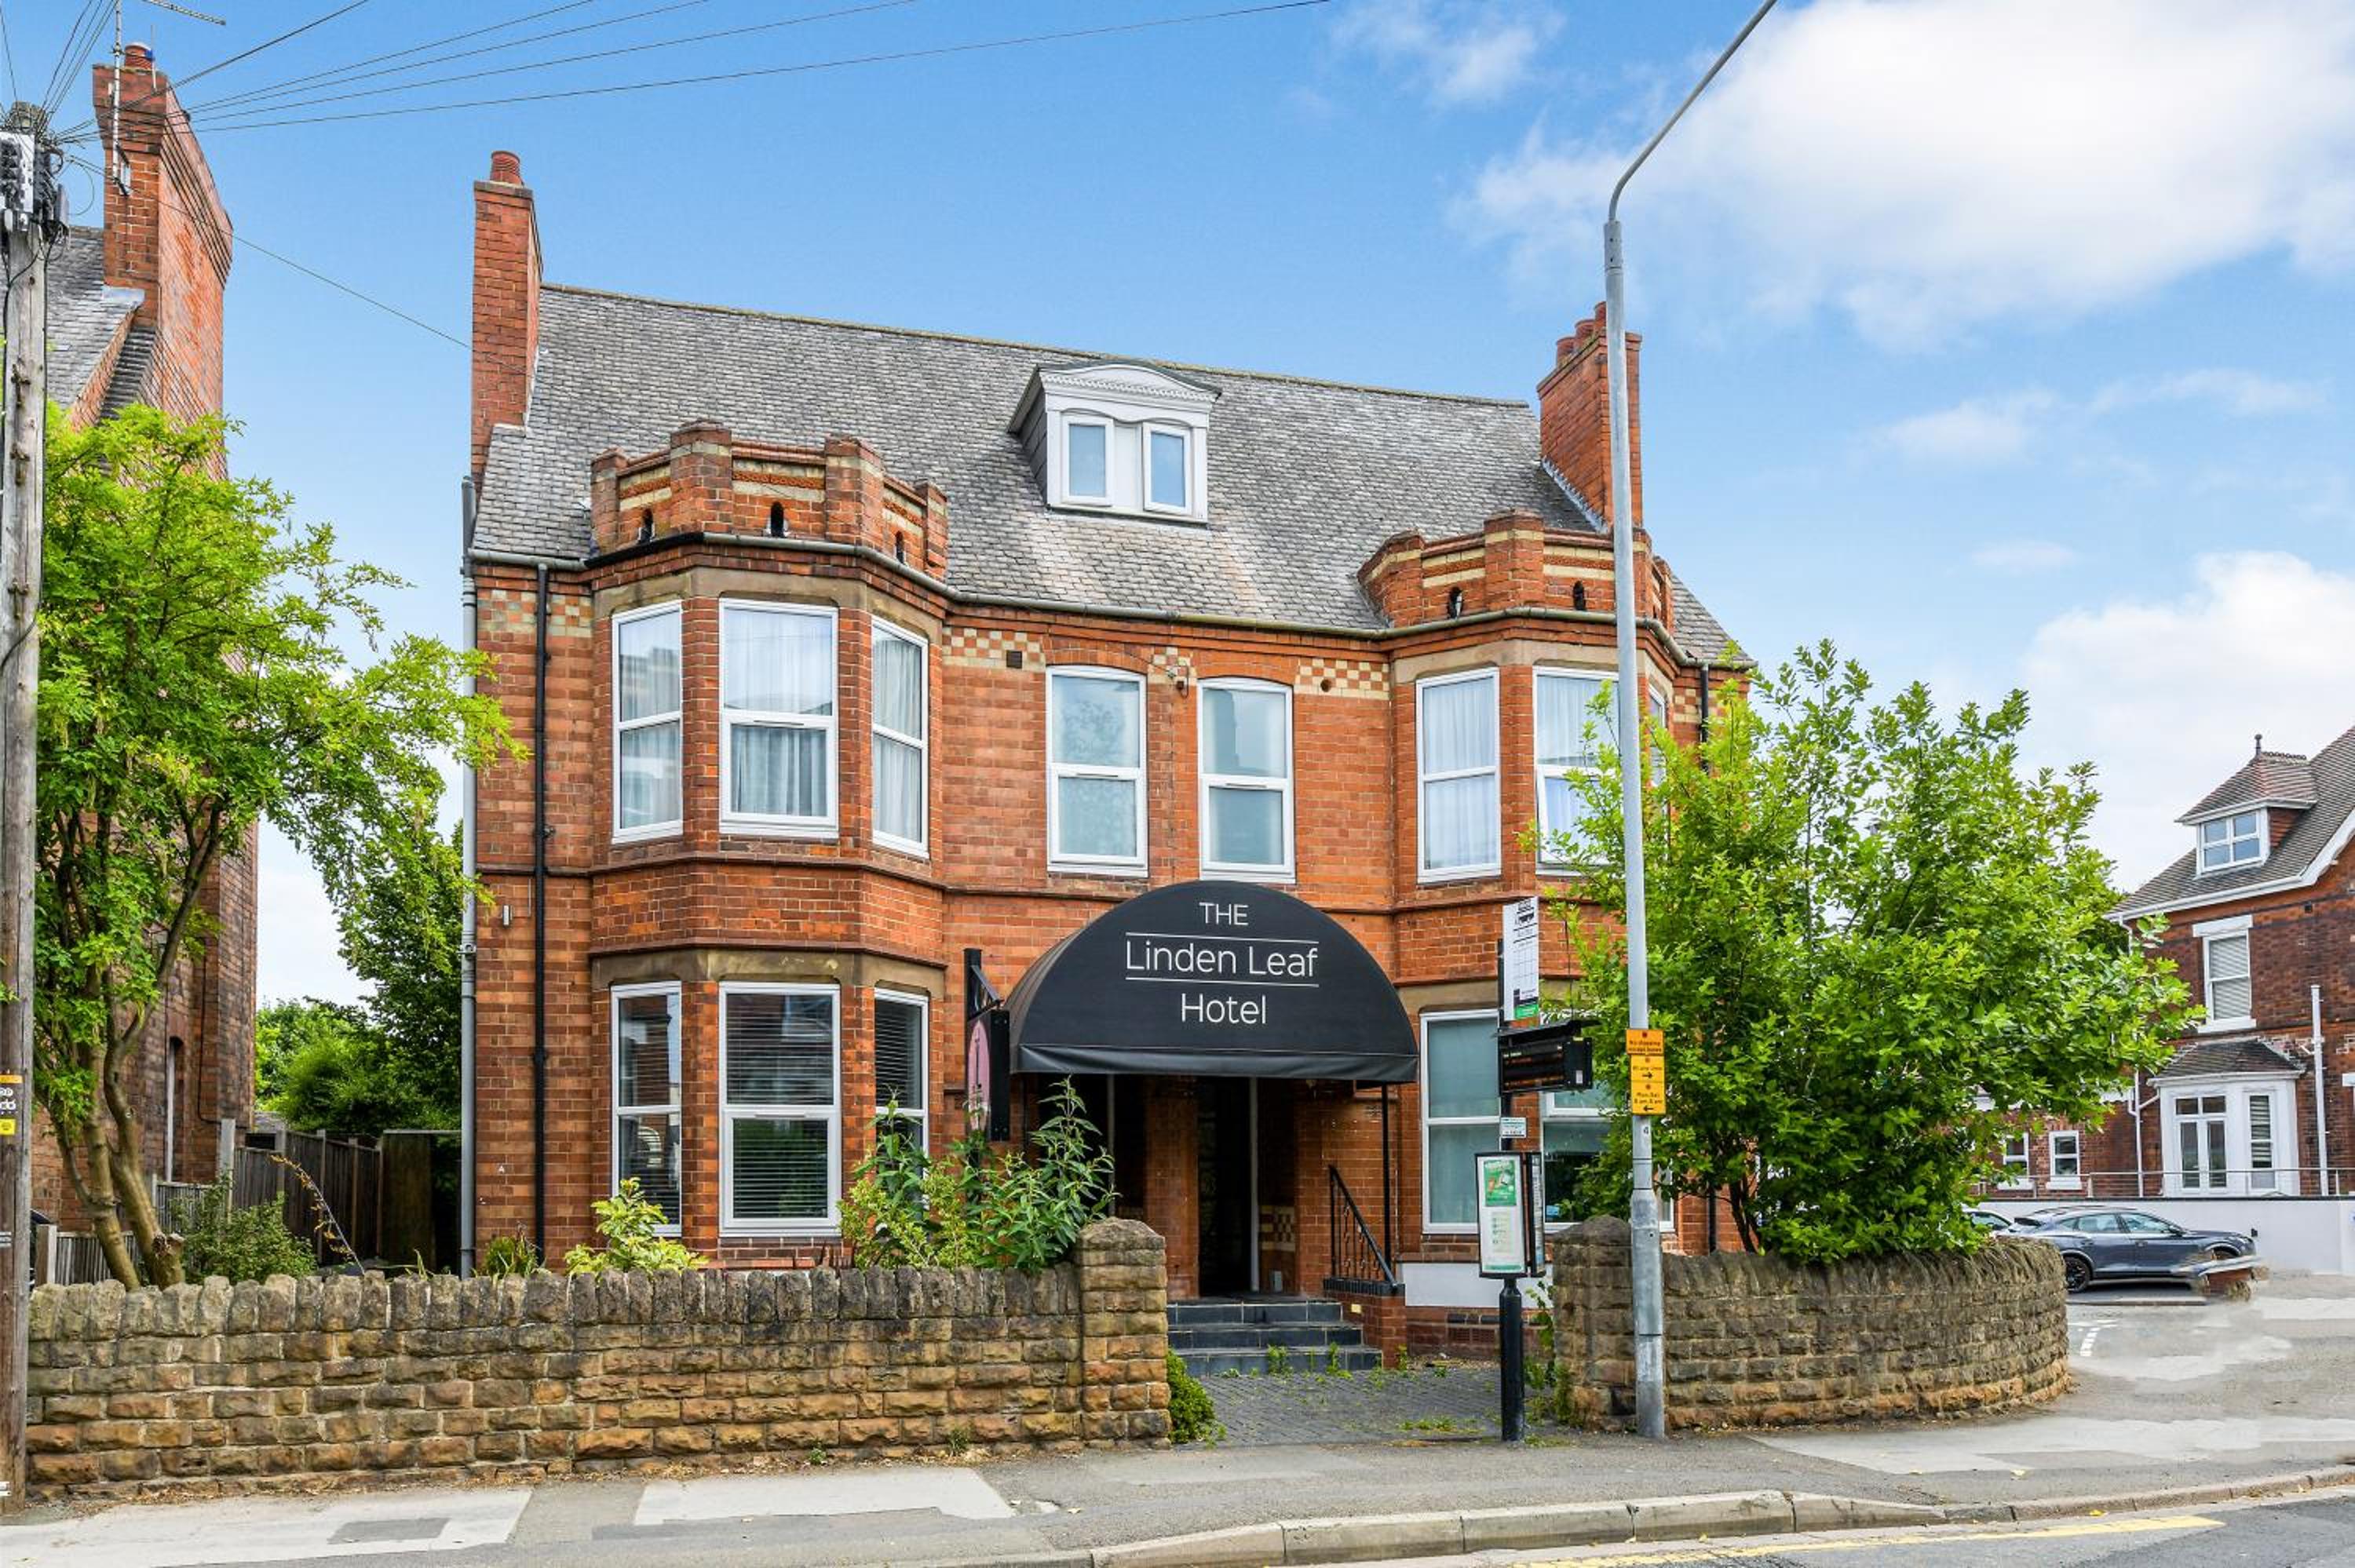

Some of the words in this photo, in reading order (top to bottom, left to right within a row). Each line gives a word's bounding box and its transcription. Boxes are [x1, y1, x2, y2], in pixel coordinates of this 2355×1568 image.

[1199, 902, 1249, 926] THE
[1126, 939, 1237, 974] Linden
[1248, 946, 1319, 977] Leaf
[1181, 992, 1267, 1025] Hotel
